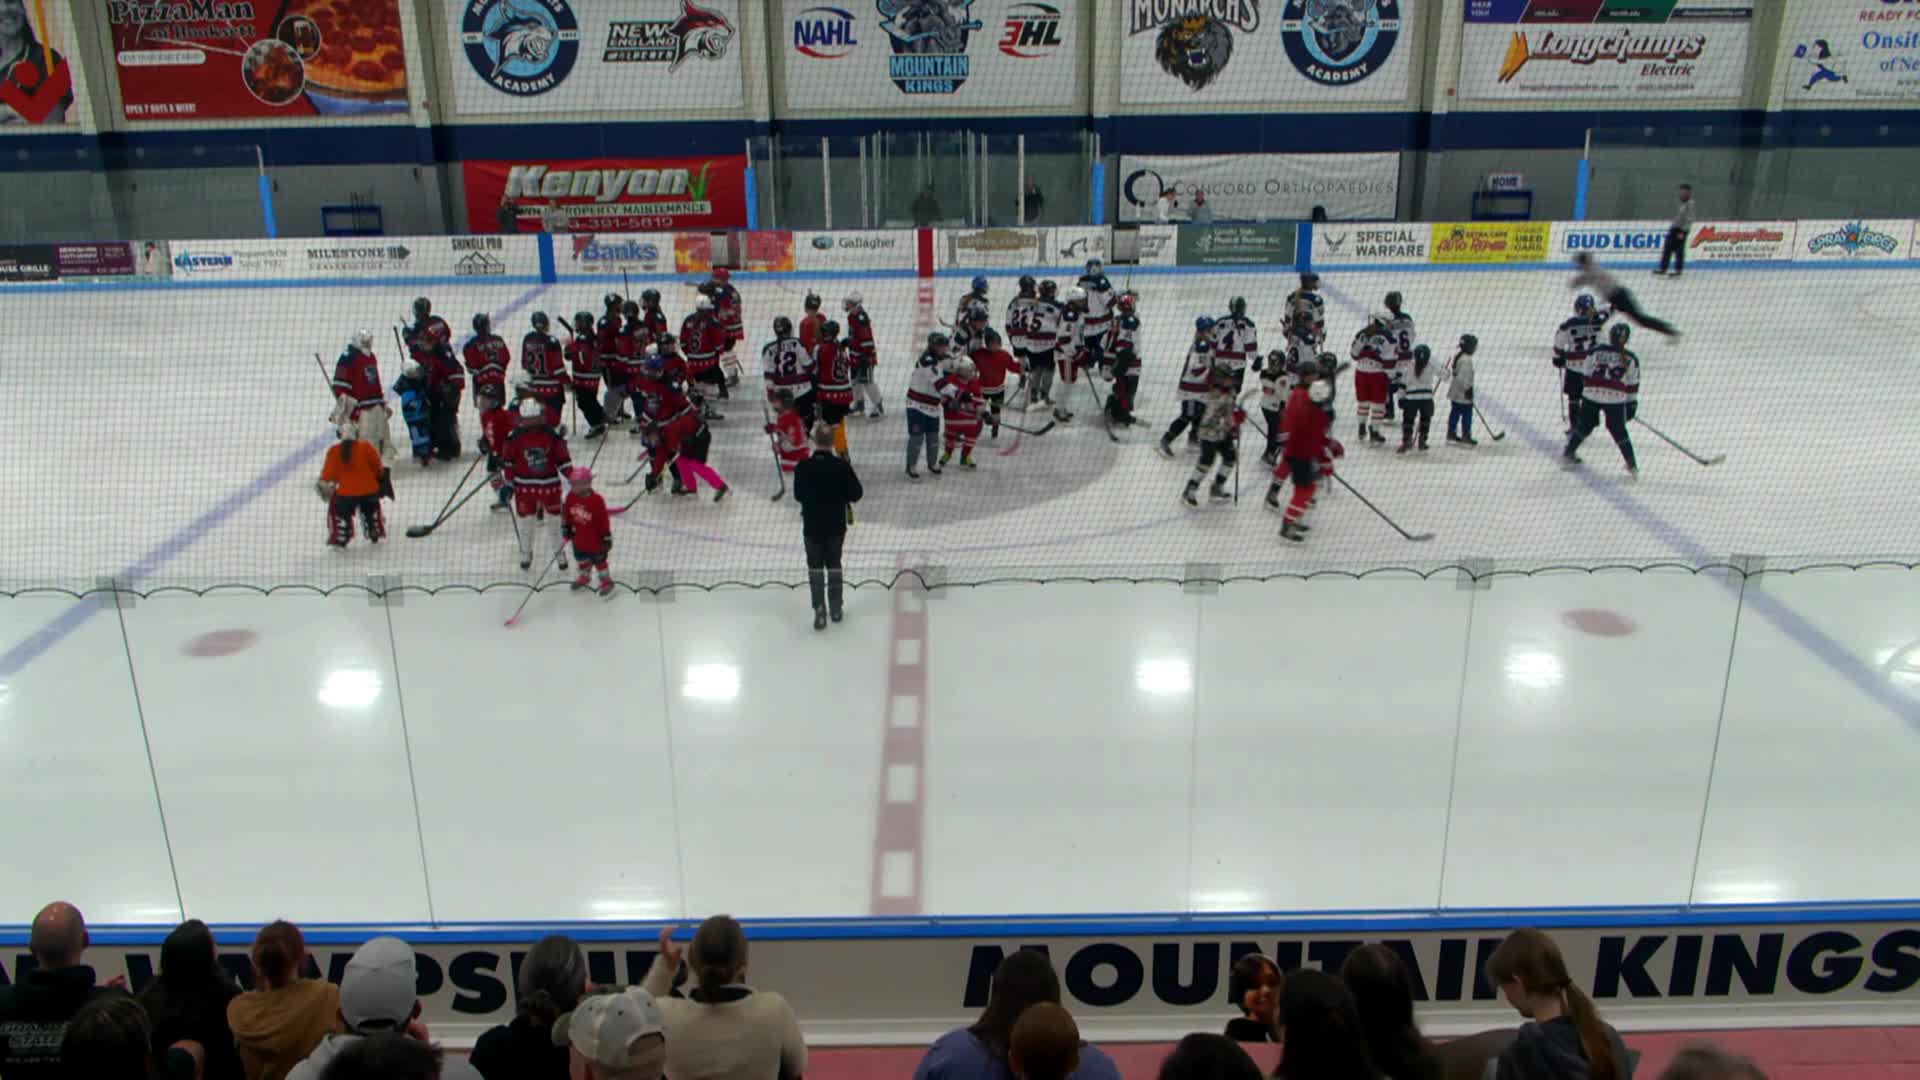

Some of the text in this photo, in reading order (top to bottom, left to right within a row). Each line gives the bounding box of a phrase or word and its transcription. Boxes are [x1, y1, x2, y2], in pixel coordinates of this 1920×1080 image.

[111, 0, 255, 23] PizzaMan
[1859, 10, 1903, 21] READY
[612, 23, 669, 38] NEW
[794, 20, 857, 46] NAHL
[998, 21, 1061, 46] 3HL
[608, 38, 676, 47] ENGLAND
[891, 56, 968, 77] MOUNTAIN
[1306, 63, 1368, 81] ACADEMY
[1640, 63, 1696, 77] Electric
[494, 72, 555, 93] ACADEMY
[905, 80, 953, 92] KINGS
[504, 165, 690, 201] Kenyon
[623, 201, 706, 214] MAINTENANCE
[839, 237, 896, 249] Gallagher
[1356, 230, 1416, 242] SPECIAL
[1567, 233, 1611, 249] BUD
[307, 247, 384, 259] MILESTONE
[1356, 245, 1425, 257] WARFARE
[1592, 929, 1920, 999] KINGS
